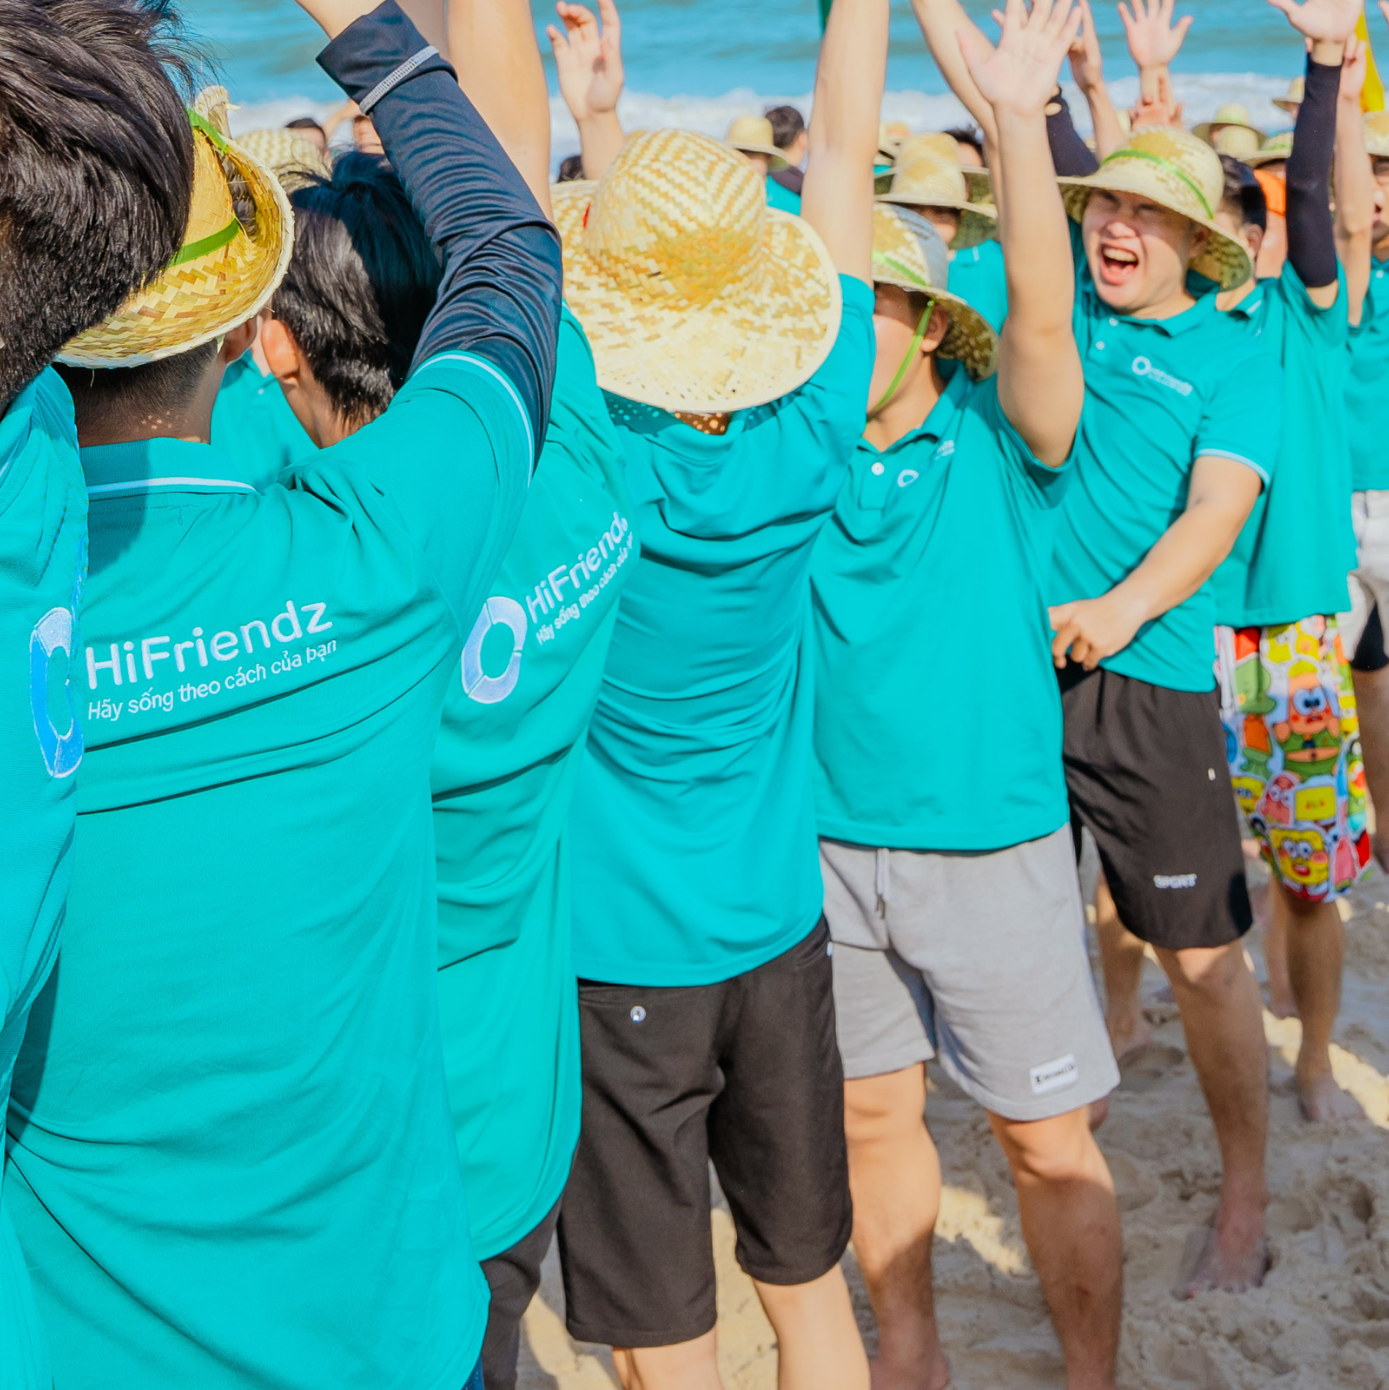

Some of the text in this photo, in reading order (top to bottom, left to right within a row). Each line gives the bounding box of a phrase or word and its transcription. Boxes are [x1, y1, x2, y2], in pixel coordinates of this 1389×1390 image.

[85, 600, 333, 690] HiFriendz
[88, 639, 338, 722] Hãy sống theo cách của bạn
